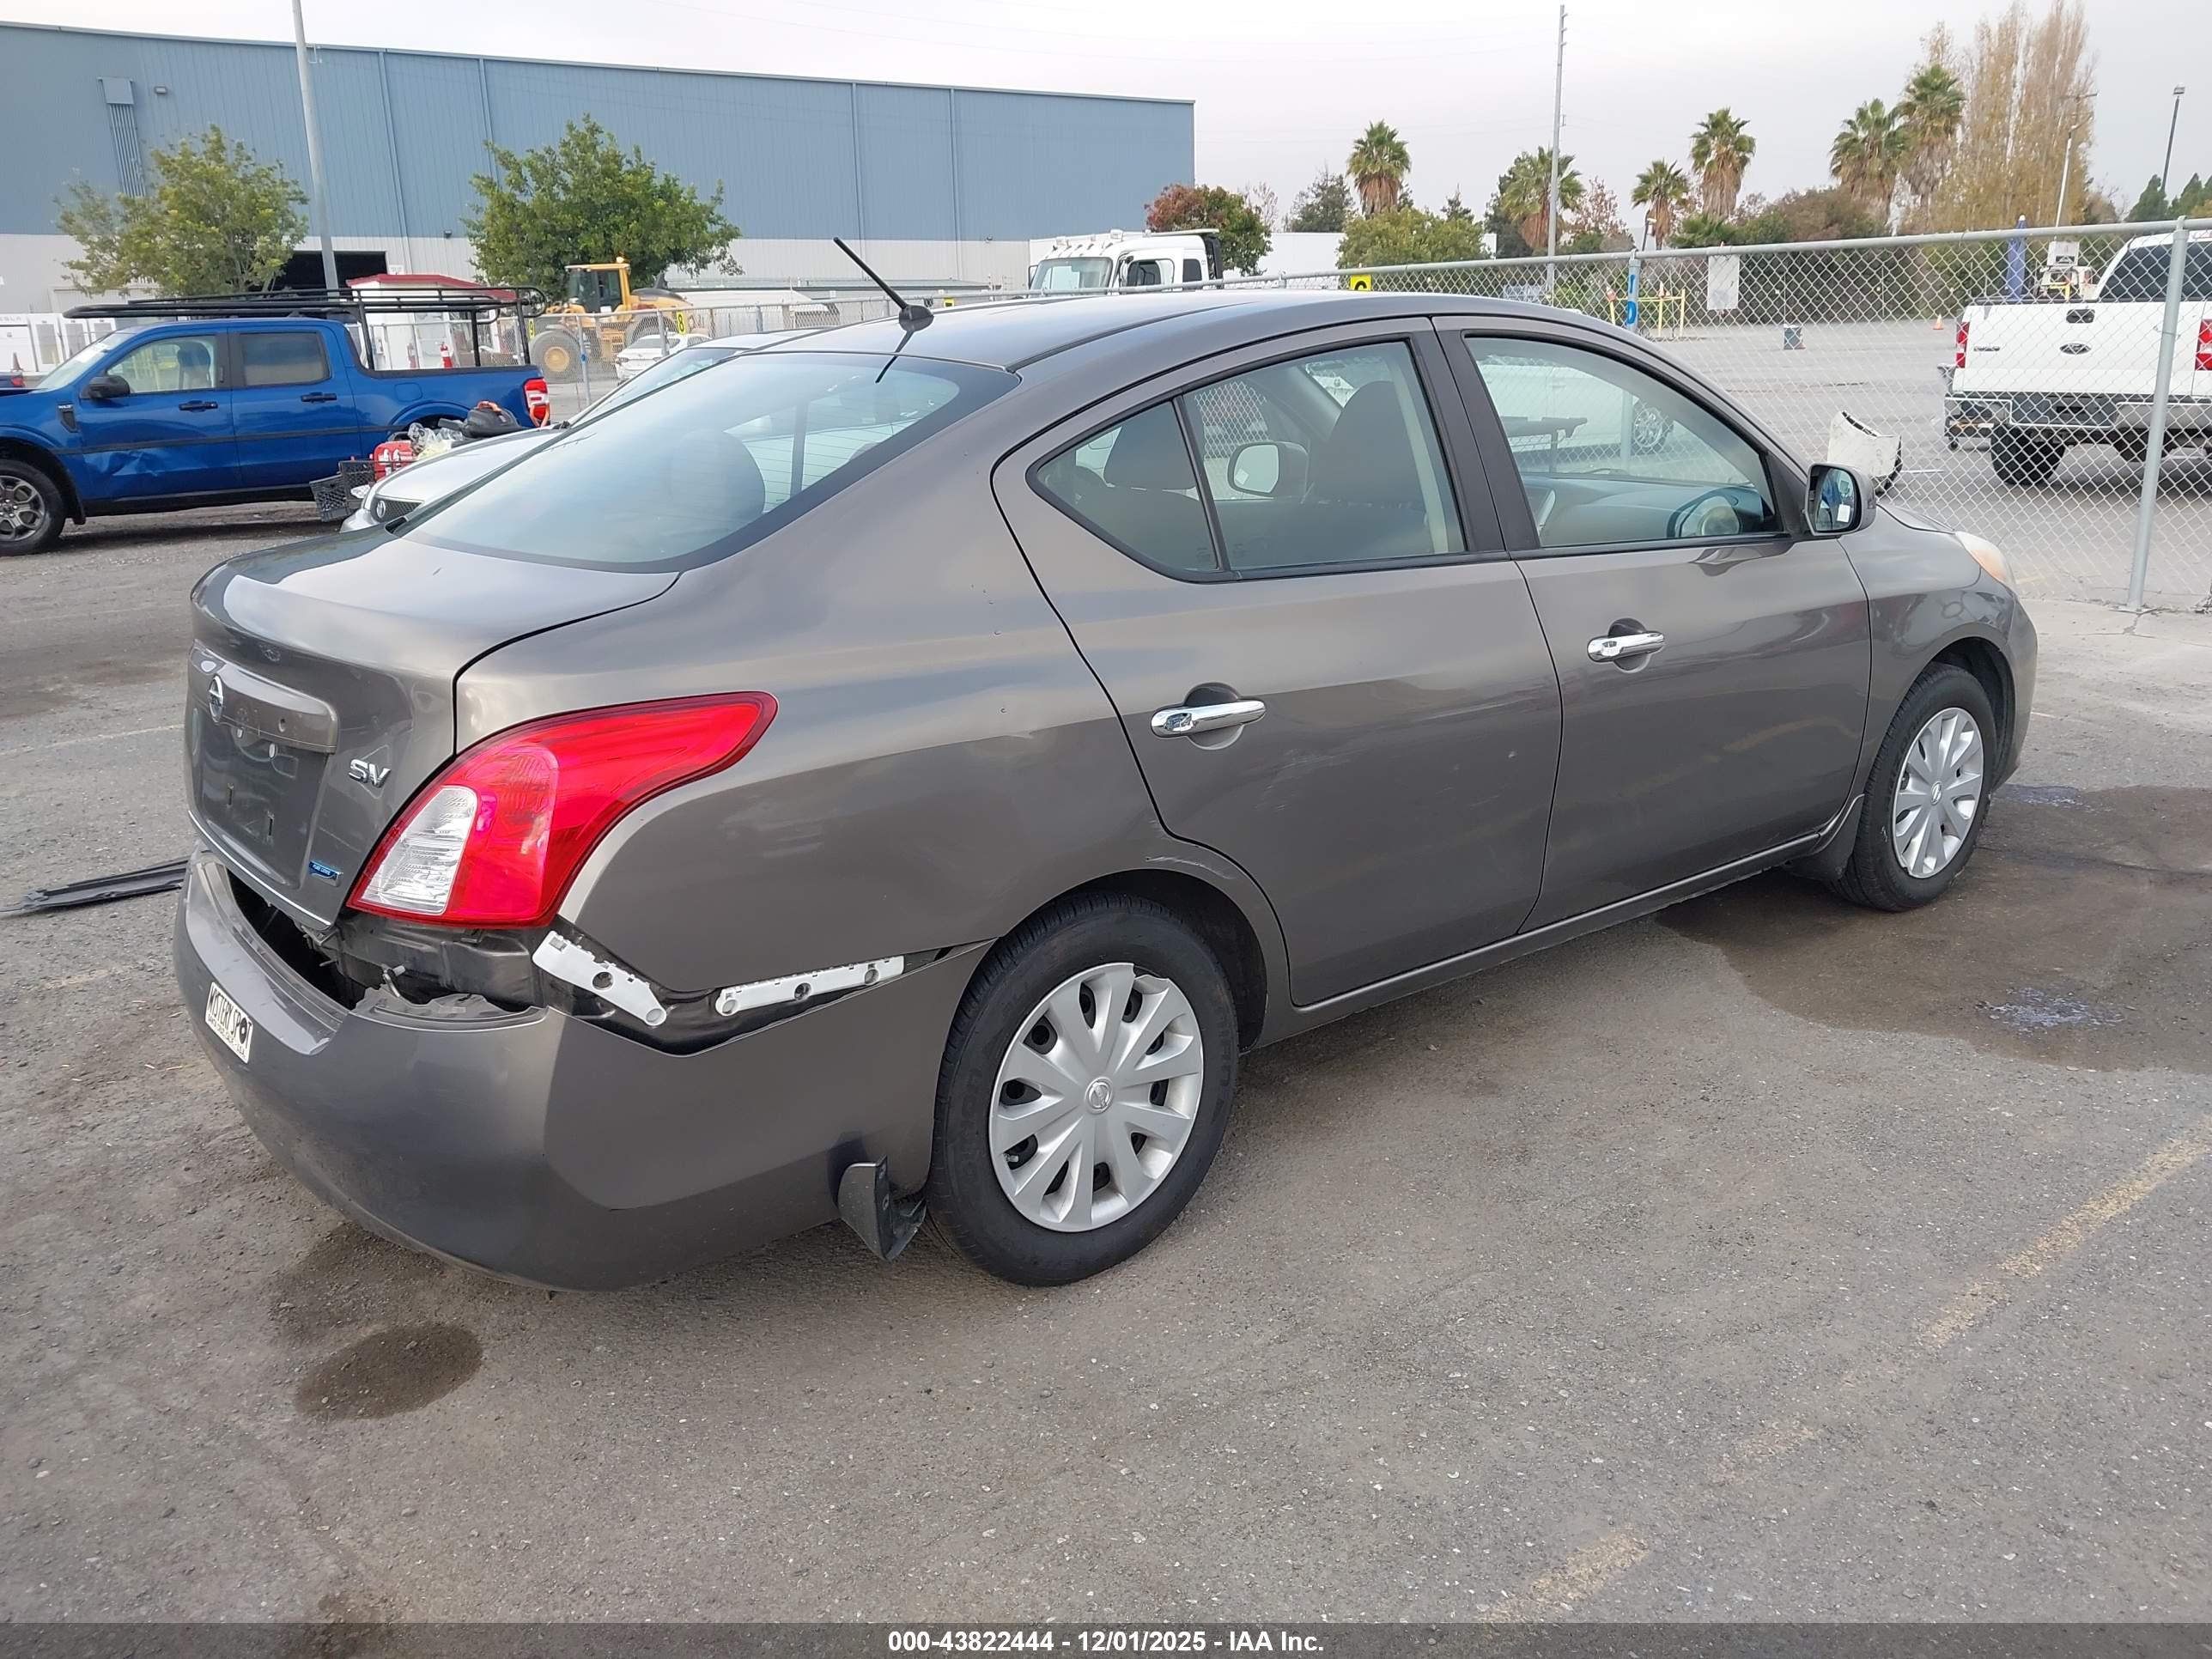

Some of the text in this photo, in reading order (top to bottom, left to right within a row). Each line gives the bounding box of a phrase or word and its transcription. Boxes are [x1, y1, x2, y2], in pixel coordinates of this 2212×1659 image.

[529, 320, 535, 337] 9
[678, 313, 684, 333] 8
[348, 758, 392, 787] SV
[207, 985, 234, 1030] MYSTERY
[230, 1008, 252, 1050] SPOT
